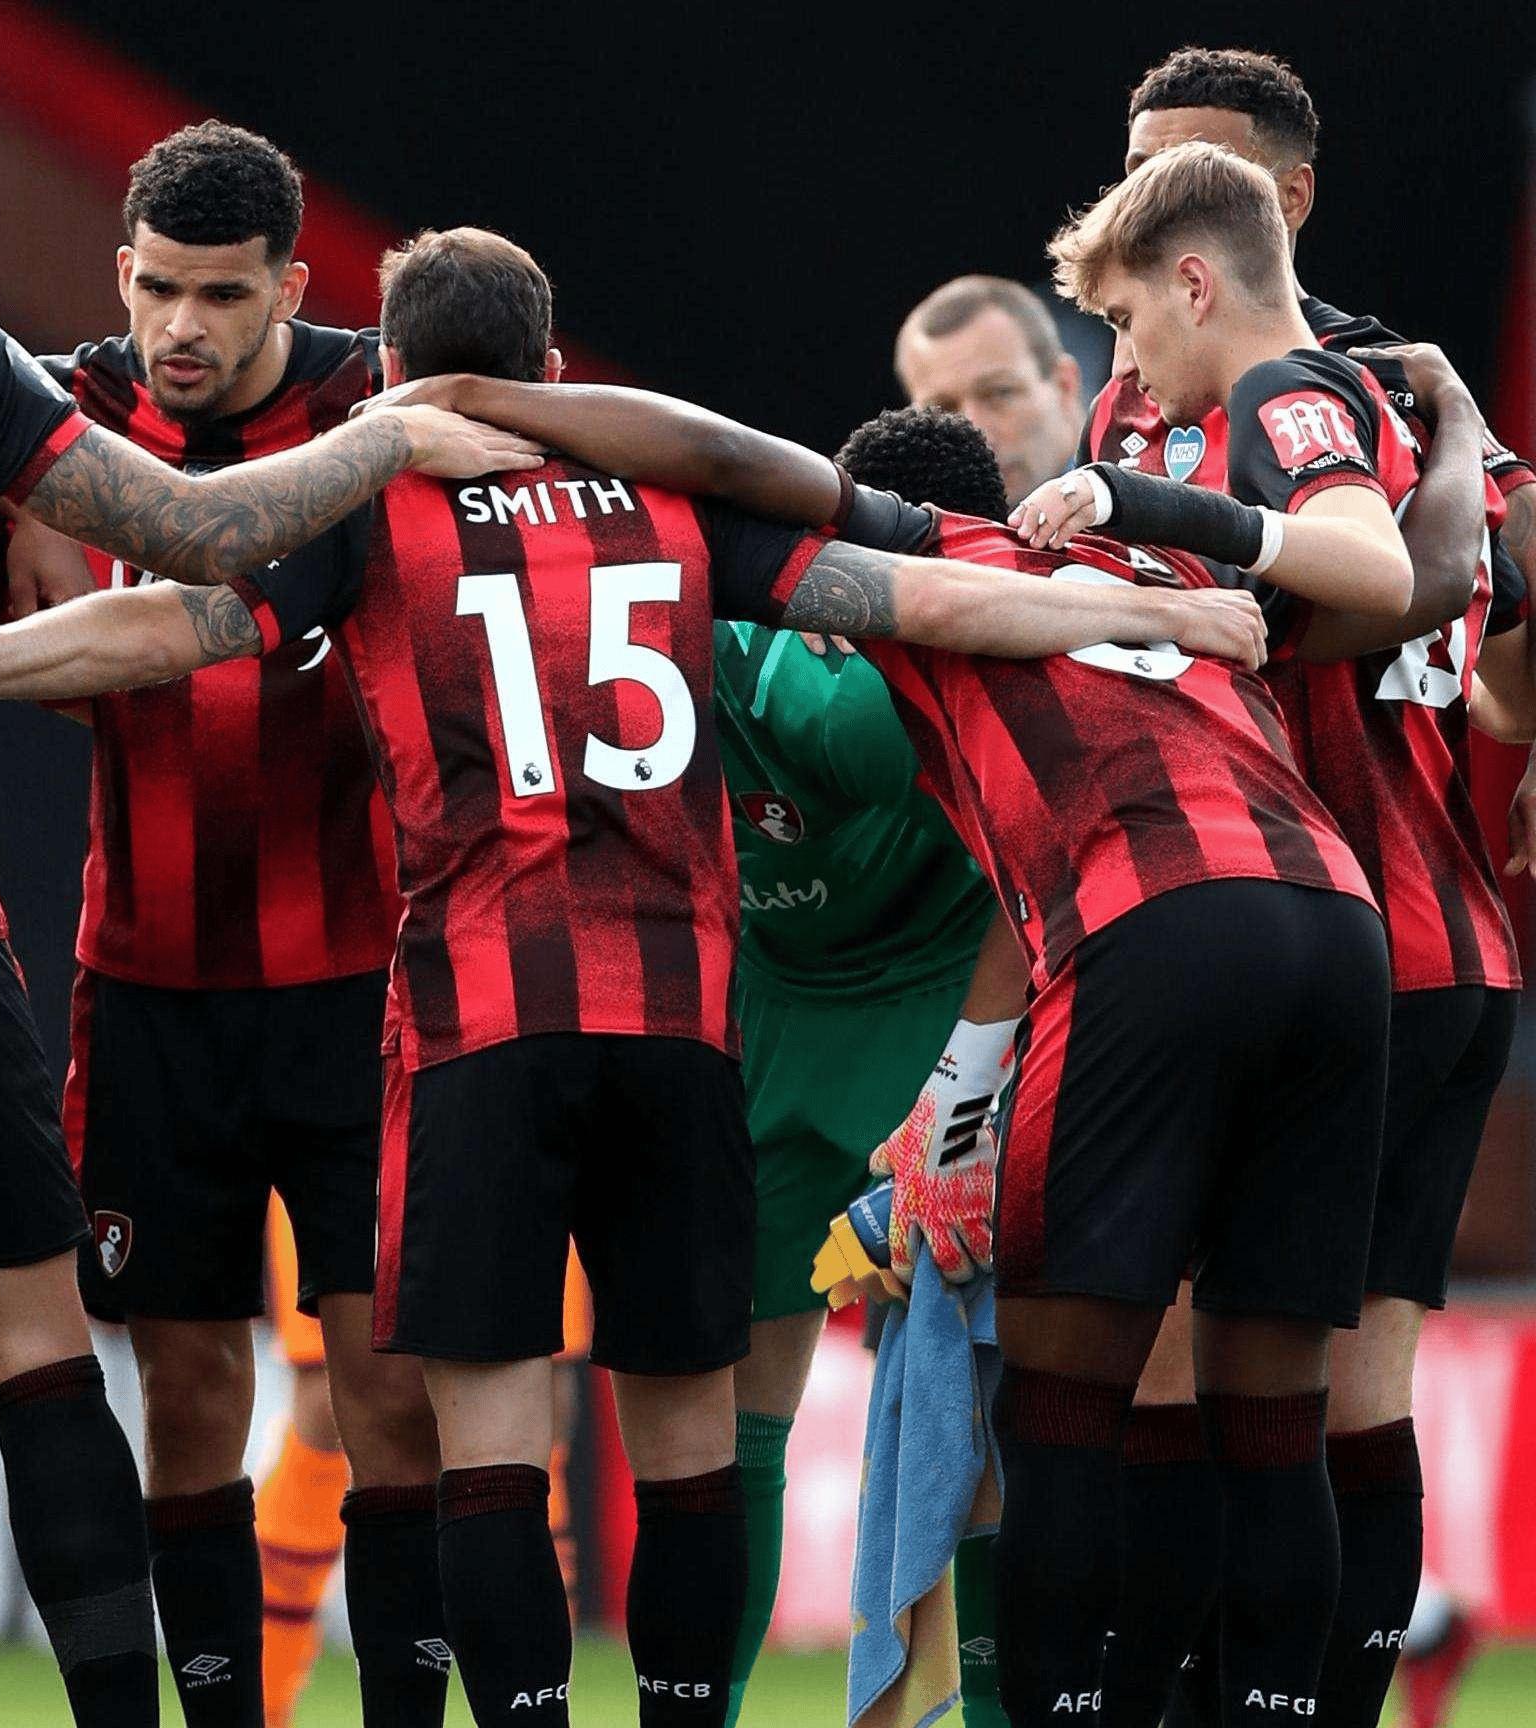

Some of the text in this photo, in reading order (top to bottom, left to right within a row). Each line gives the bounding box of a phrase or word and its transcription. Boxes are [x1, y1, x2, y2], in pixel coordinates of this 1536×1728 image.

[1174, 444, 1199, 460] NHS
[458, 478, 636, 525] SMITH
[455, 562, 697, 797] 15
[186, 1672, 232, 1688] umbro
[638, 1674, 711, 1698] AFCB
[1245, 1688, 1316, 1716] AFCB
